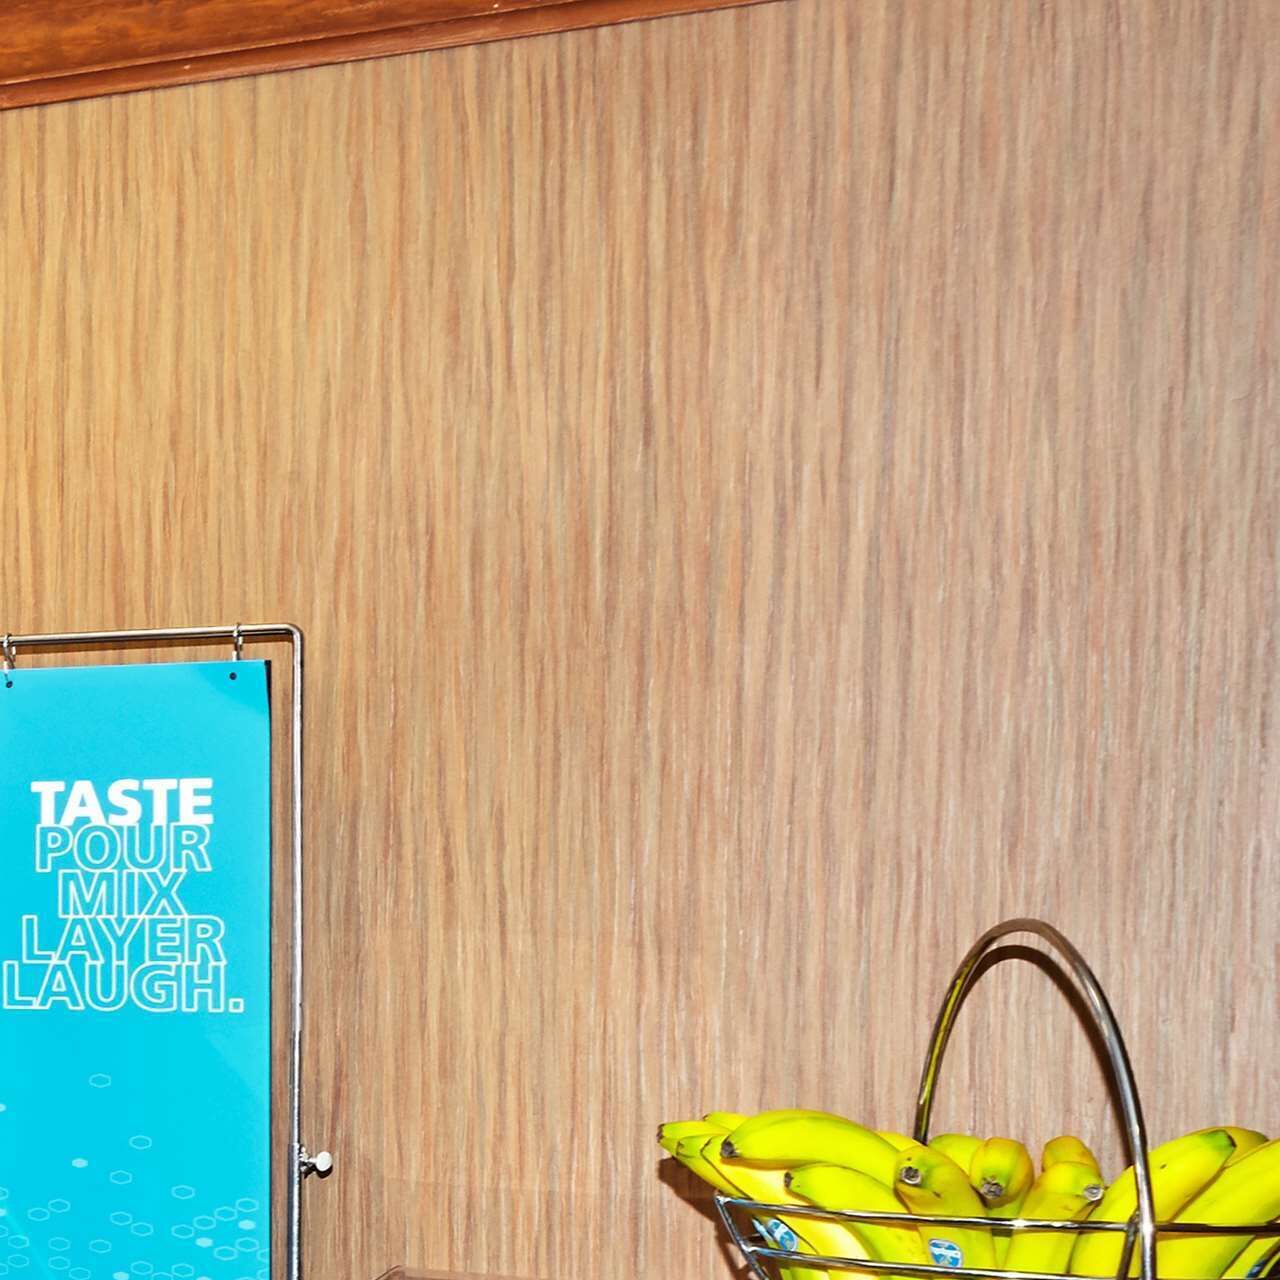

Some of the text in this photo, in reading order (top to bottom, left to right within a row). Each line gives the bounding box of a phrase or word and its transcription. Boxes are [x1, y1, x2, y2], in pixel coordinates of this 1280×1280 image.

[30, 777, 214, 826] TASTE
[35, 822, 212, 872] POUR
[57, 868, 188, 919] MIX
[21, 914, 228, 966] LAYER
[2, 959, 245, 1014] LAUGH.
